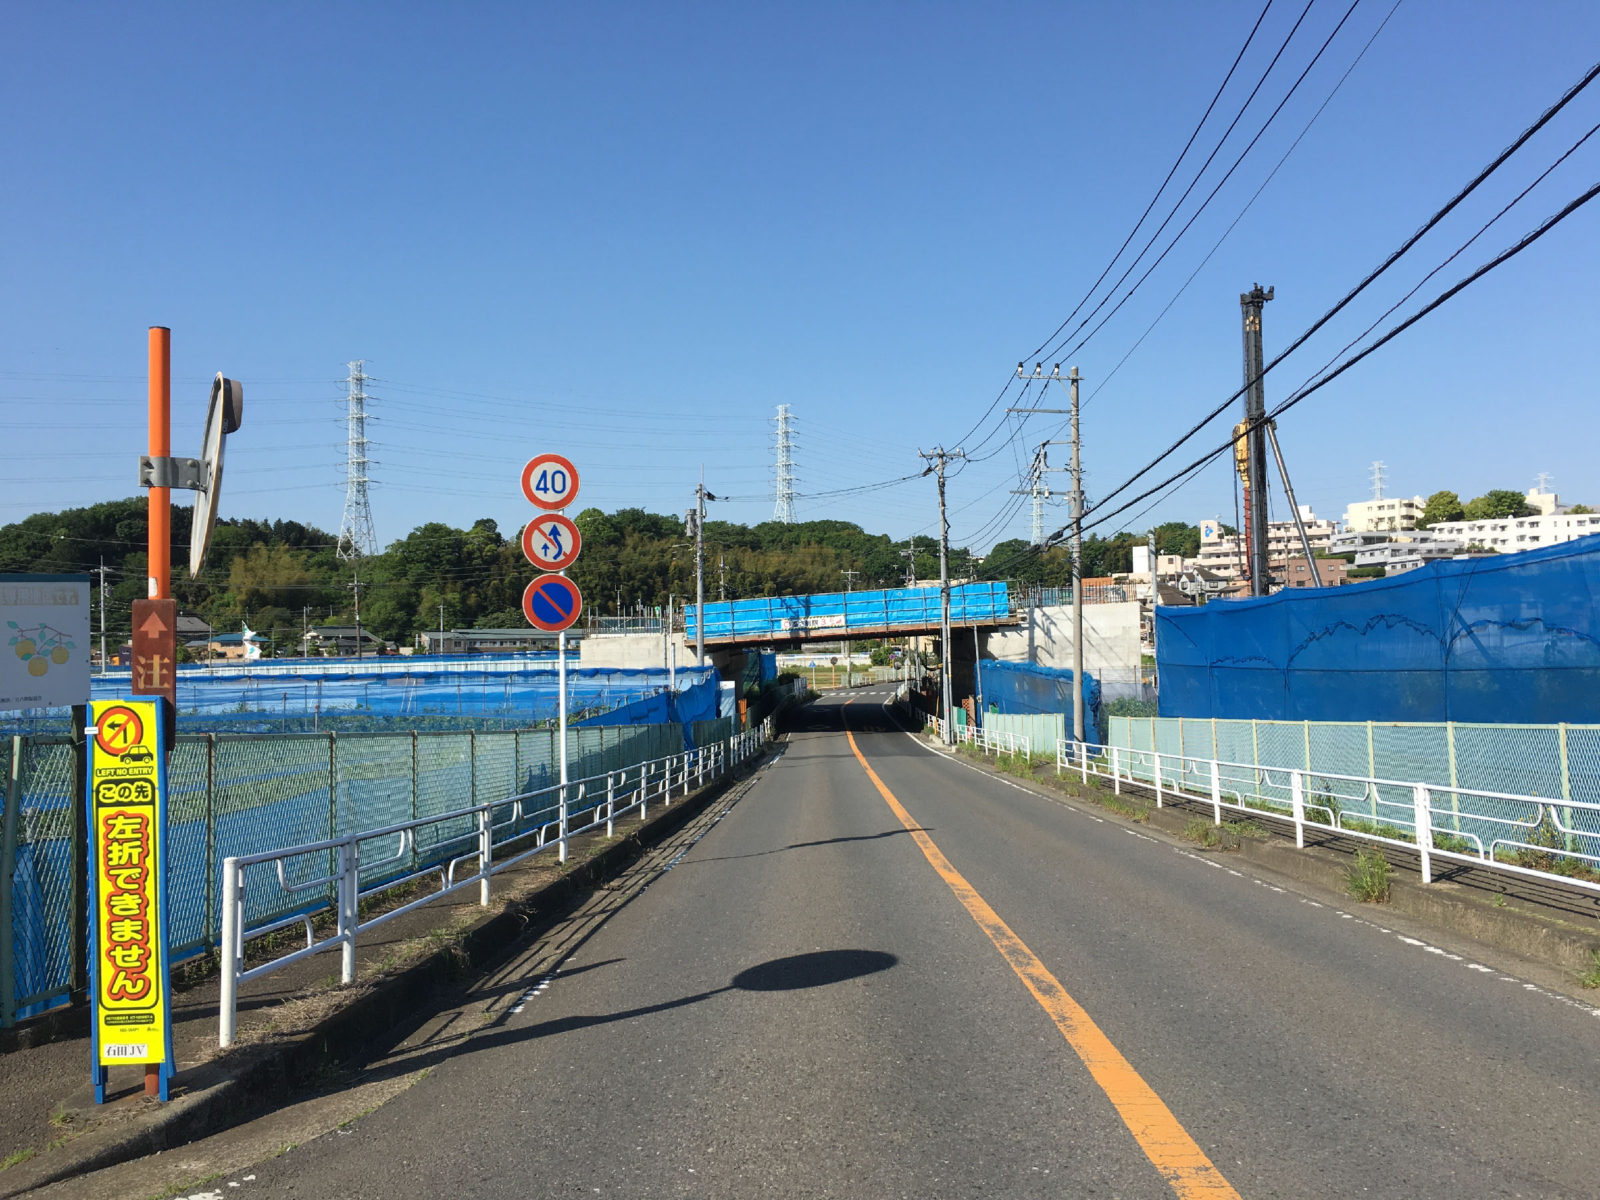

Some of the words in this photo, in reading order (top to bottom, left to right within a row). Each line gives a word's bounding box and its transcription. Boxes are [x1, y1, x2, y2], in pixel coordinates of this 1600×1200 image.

[535, 469, 566, 494] 40
[96, 769, 115, 777] LEFT
[116, 768, 128, 776] NO
[128, 766, 153, 776] ENTRY
[101, 783, 150, 800] この先
[106, 814, 146, 996] 左折できません
